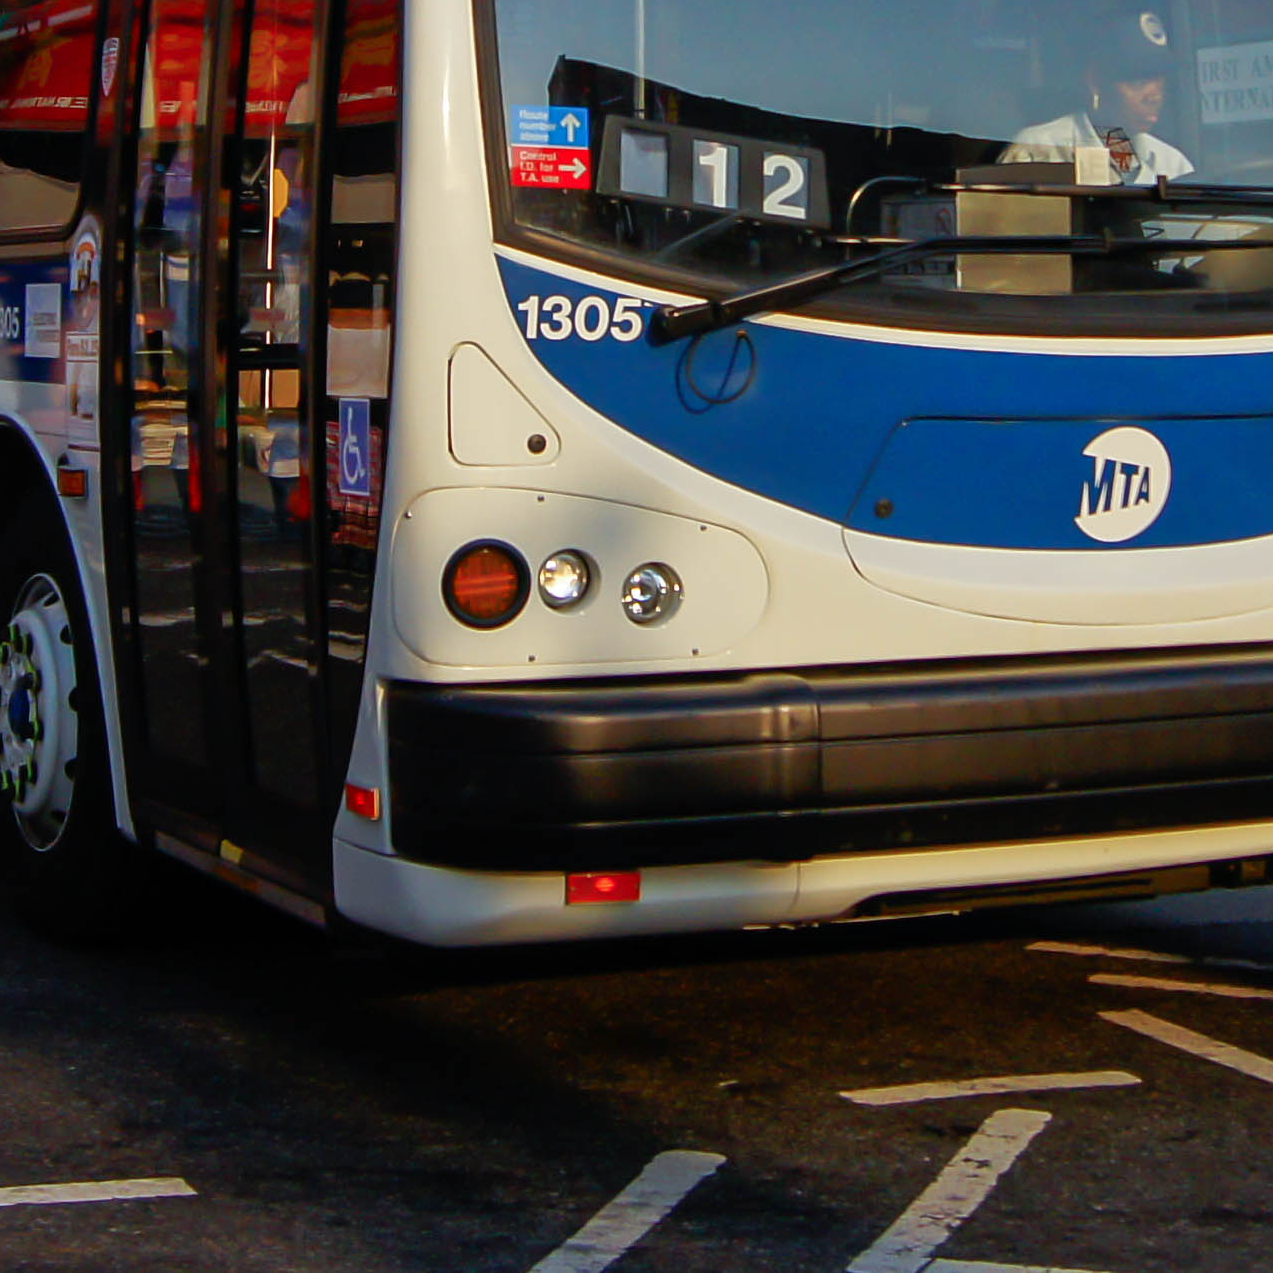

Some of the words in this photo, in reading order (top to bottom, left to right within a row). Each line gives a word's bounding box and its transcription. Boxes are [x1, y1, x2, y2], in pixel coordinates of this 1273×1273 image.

[1200, 59, 1239, 84] IRST
[519, 150, 557, 161] Control
[517, 294, 643, 342] 1305
